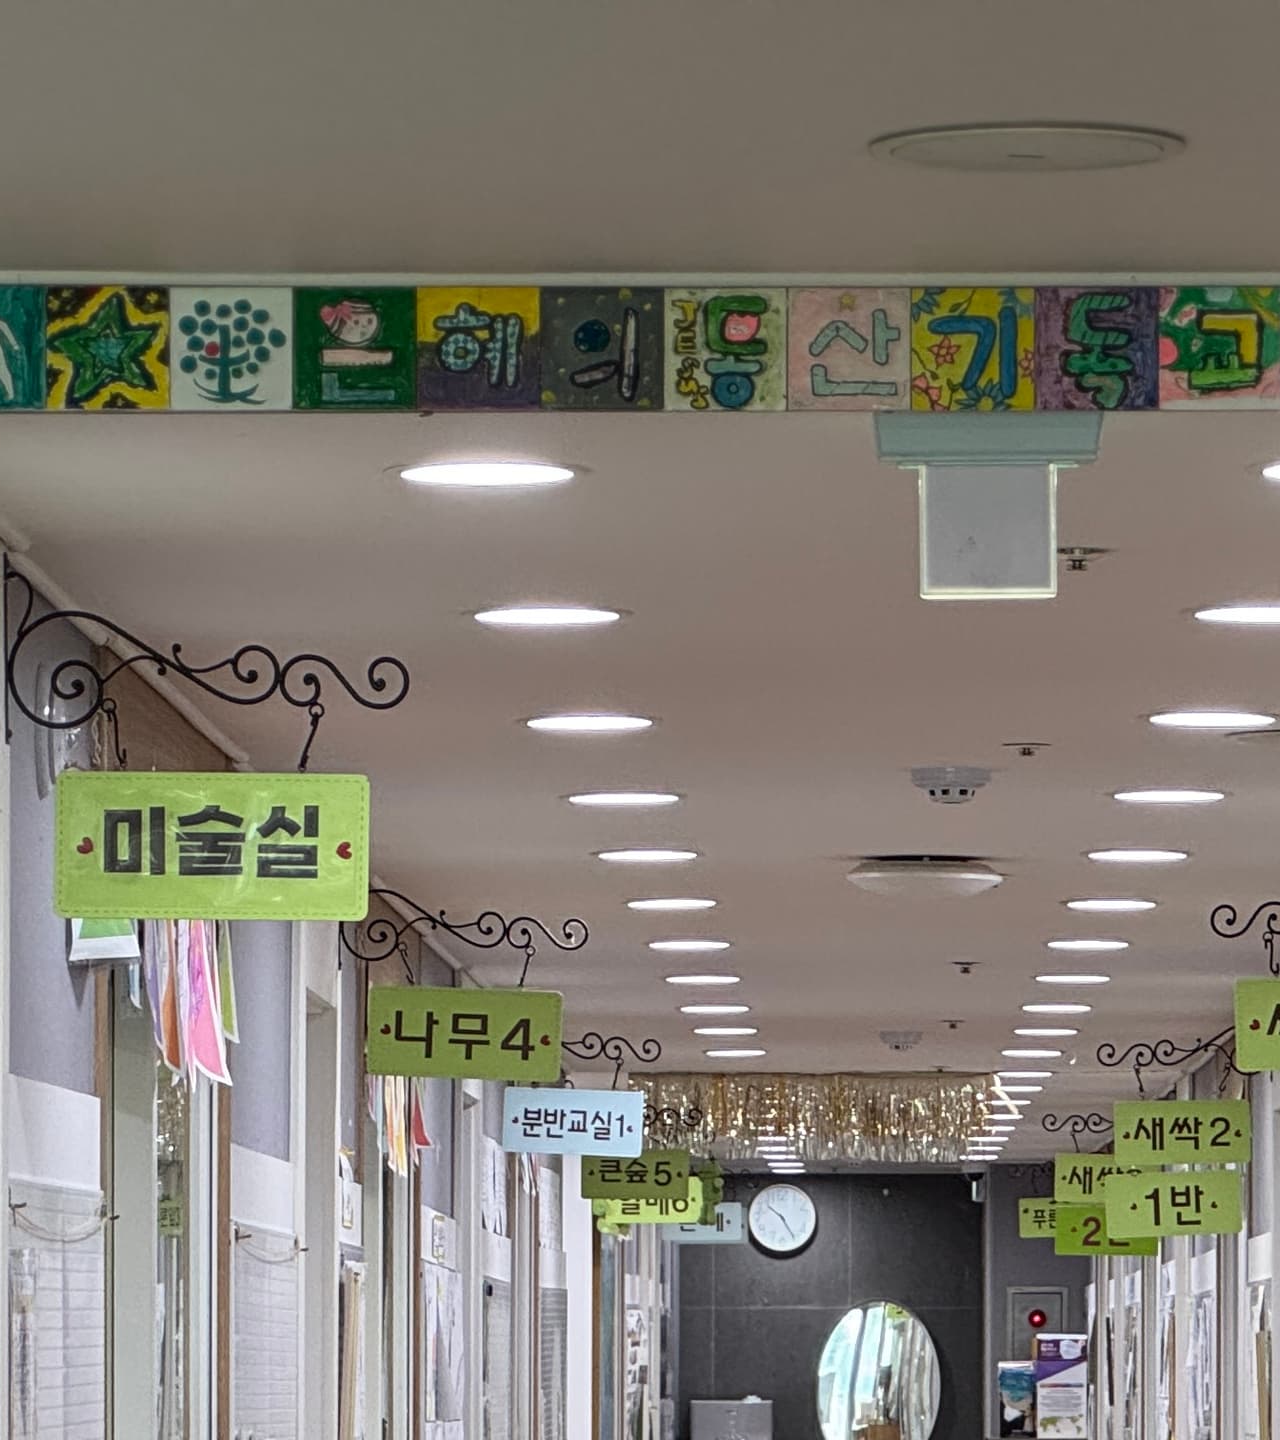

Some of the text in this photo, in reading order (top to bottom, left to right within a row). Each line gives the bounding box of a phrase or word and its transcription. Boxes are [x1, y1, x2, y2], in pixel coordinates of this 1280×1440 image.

[103, 805, 319, 879] 미술실
[522, 1107, 625, 1140] 분반교실1
[1145, 1185, 1204, 1226] 1반
